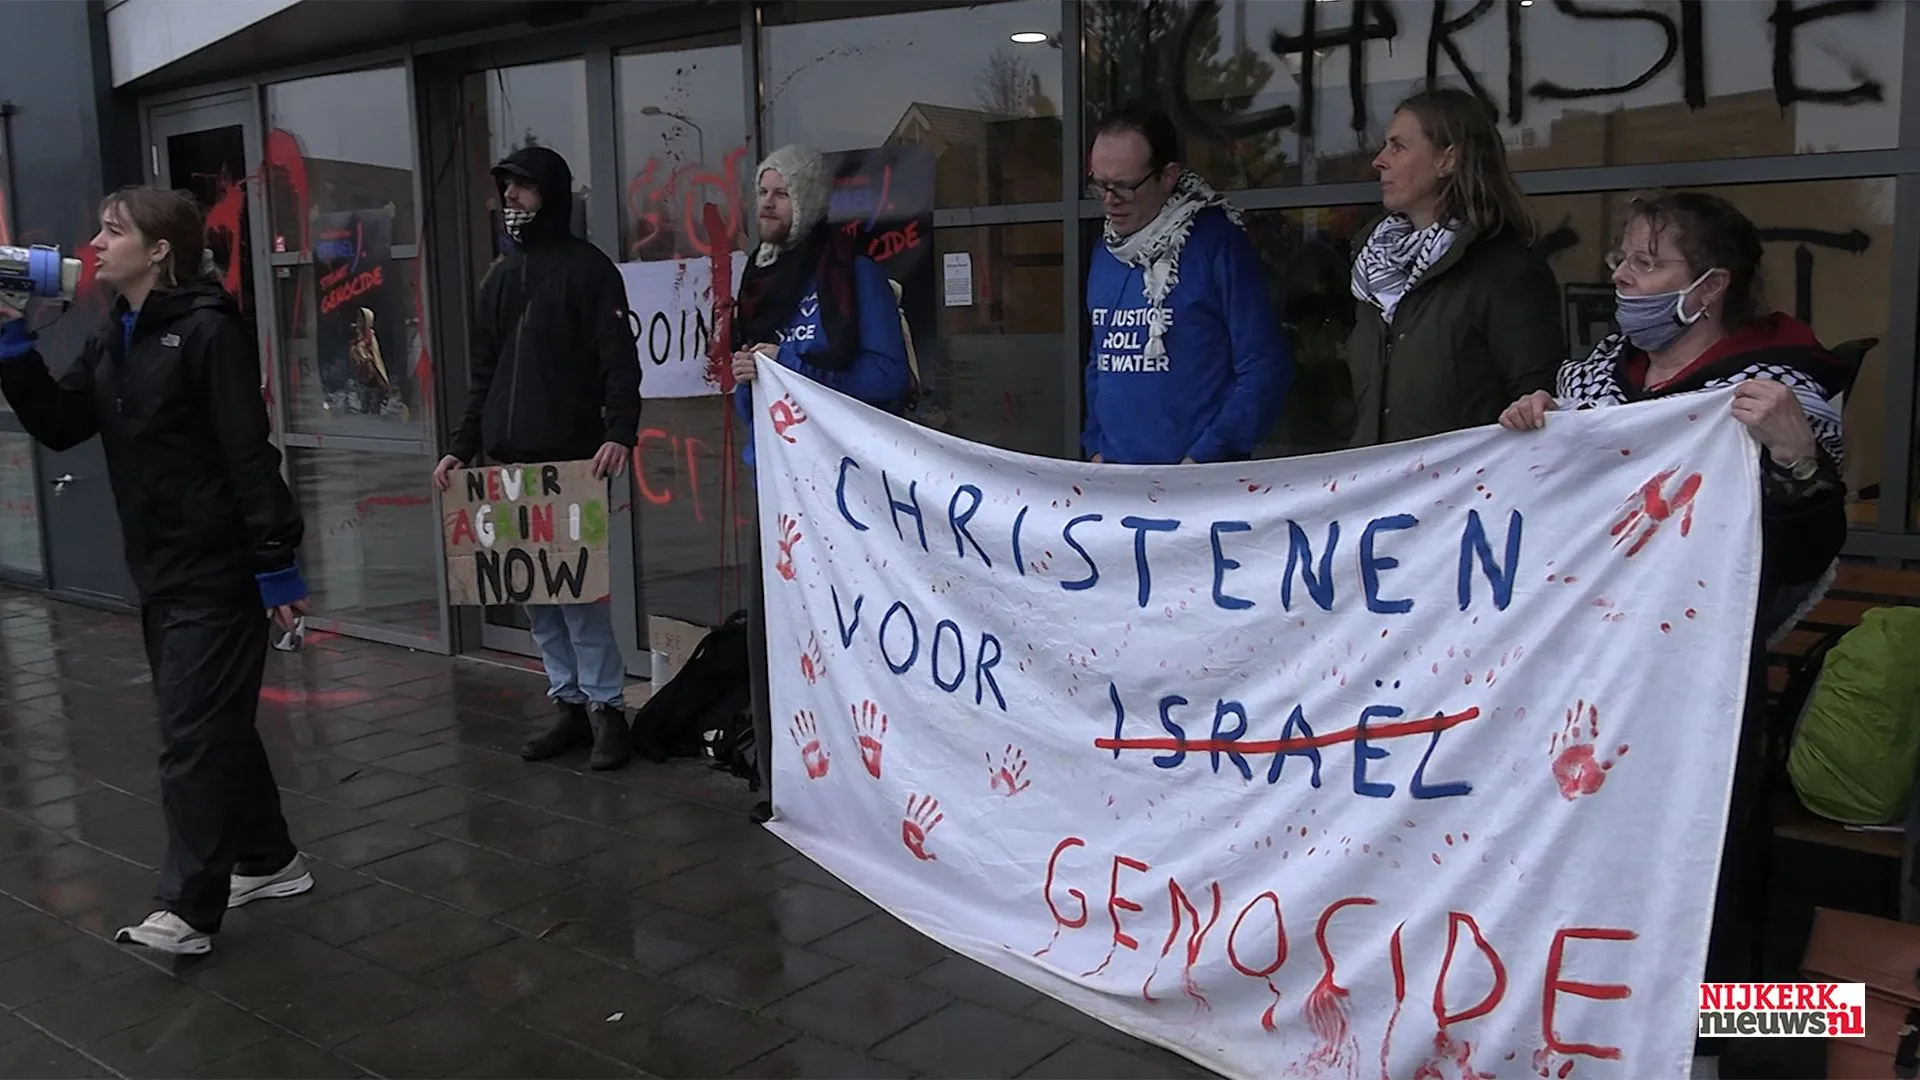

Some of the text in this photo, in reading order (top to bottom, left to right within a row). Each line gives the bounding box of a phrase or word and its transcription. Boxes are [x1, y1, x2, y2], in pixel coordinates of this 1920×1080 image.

[321, 265, 384, 314] GENOCIDE
[1103, 331, 1141, 349] ROLL
[1111, 307, 1173, 327] JUSTICE
[1111, 354, 1170, 372] WATER
[466, 465, 561, 502] NEVER
[452, 497, 606, 548] AGAIN IS
[836, 455, 1522, 613] CHRISTENEN
[475, 546, 588, 606] NOW
[831, 584, 1007, 711] VOOR
[1043, 837, 1640, 1061] GENOCIDE
